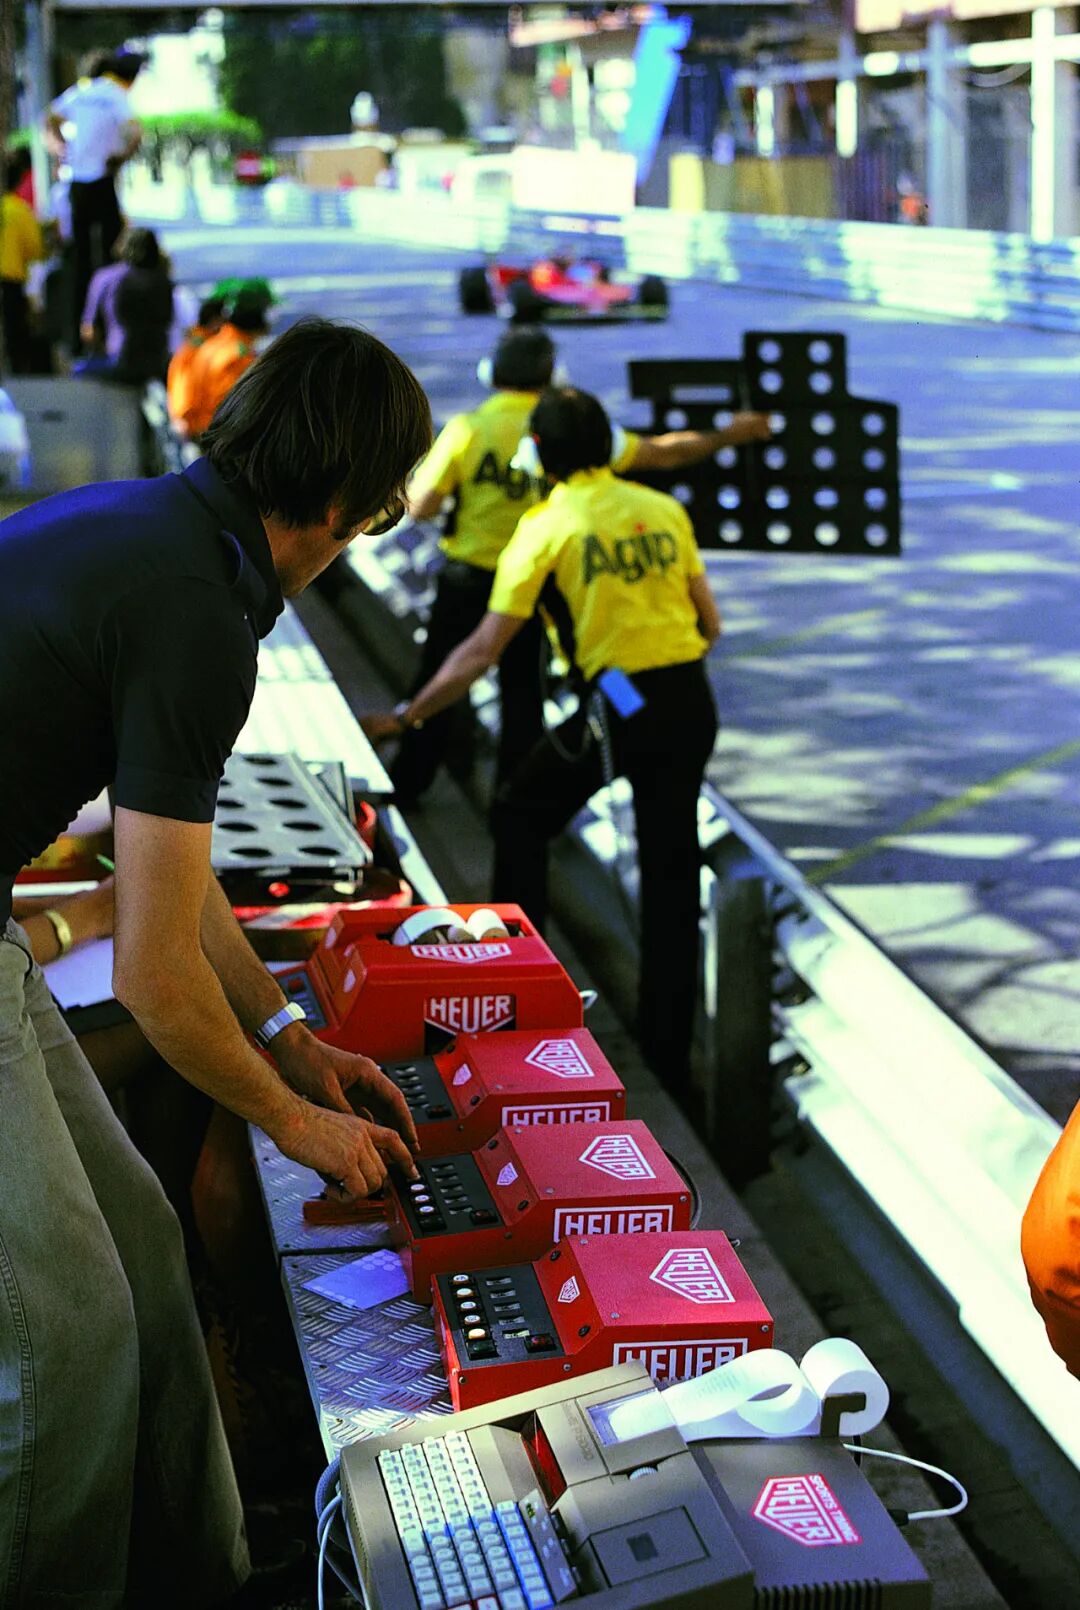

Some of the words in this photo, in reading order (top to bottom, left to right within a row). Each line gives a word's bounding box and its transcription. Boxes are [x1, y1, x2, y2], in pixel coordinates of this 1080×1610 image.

[472, 450, 546, 501] Ag
[582, 524, 677, 585] Agip
[430, 994, 512, 1033] HEUER
[590, 1138, 648, 1177] HEUER
[661, 1253, 725, 1299] HEUER
[765, 1482, 832, 1539] HEUER
